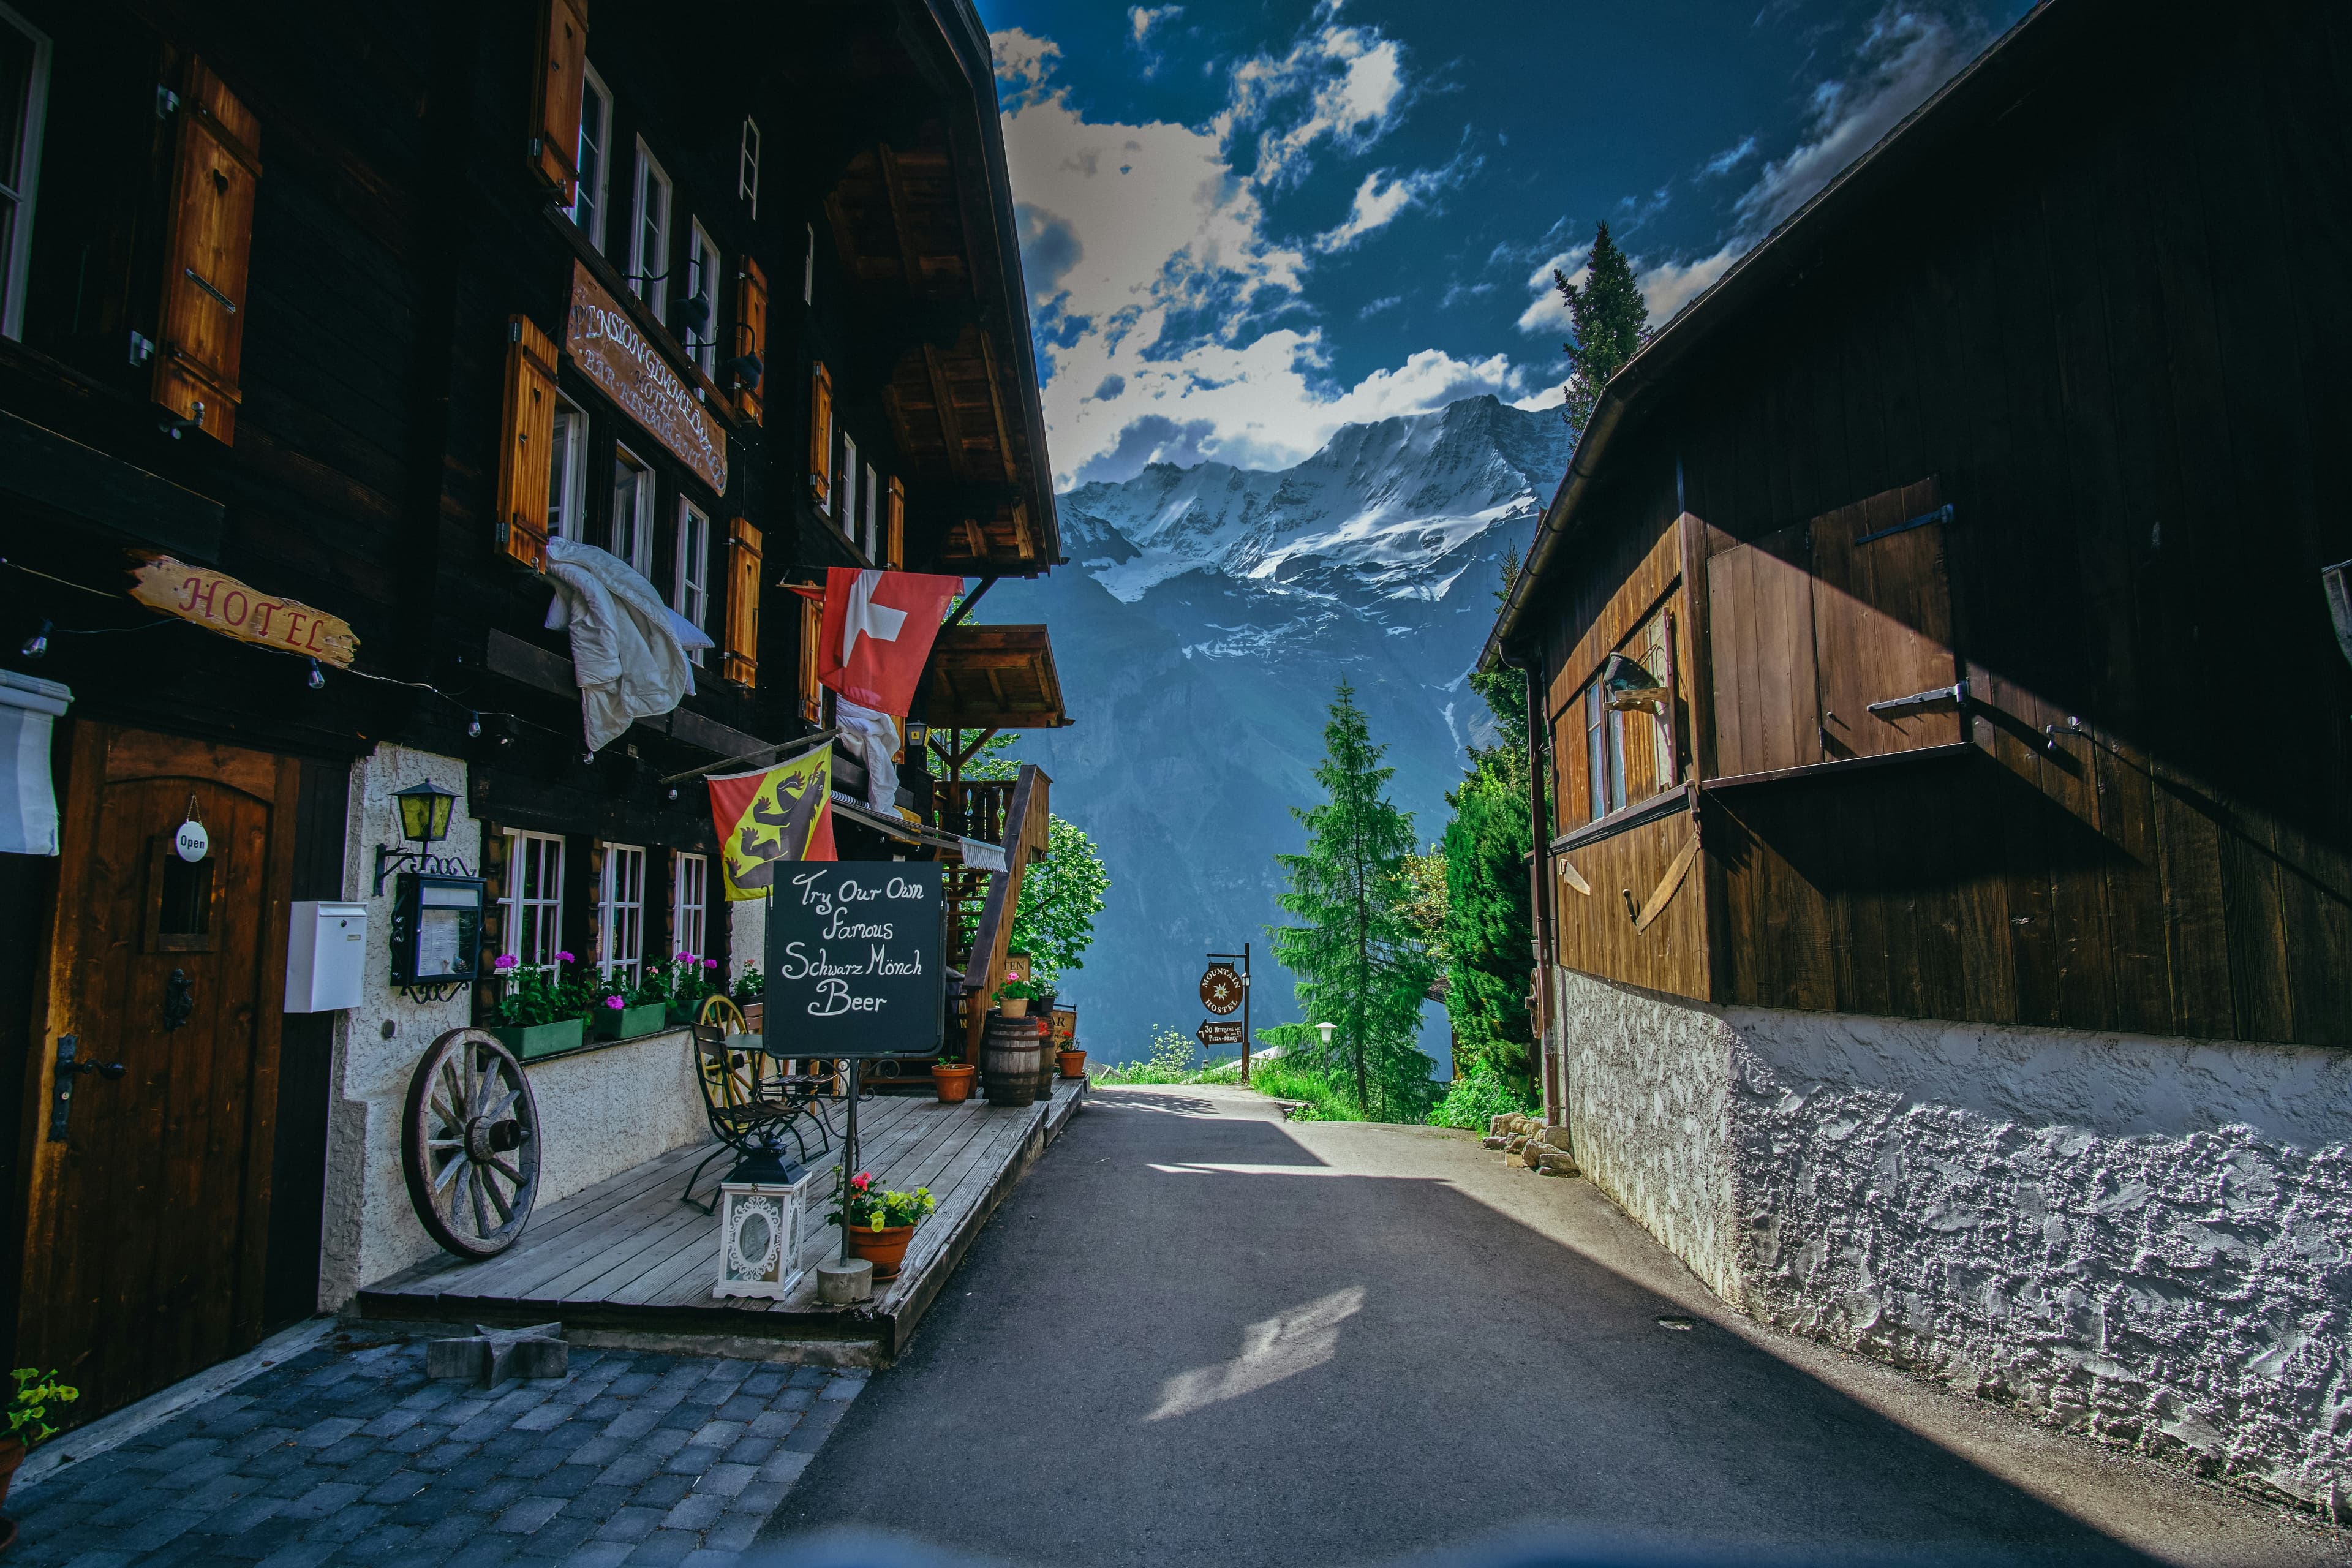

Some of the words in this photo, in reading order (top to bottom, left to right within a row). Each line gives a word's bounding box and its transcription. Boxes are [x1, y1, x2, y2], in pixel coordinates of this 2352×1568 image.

[572, 305, 647, 363] PENSION
[584, 349, 615, 390] BAR
[619, 382, 701, 469] RESTAURANT
[633, 370, 673, 421] HOTEL
[178, 577, 325, 653] HOTEL
[181, 835, 205, 850] Open
[792, 869, 832, 916] Try
[839, 880, 882, 902] Our
[886, 876, 924, 899] Own
[782, 941, 864, 979] Schwarz
[865, 943, 922, 976] Mönch
[1202, 968, 1241, 989] MOUNTAIN
[807, 978, 888, 1016] Beer
[1205, 998, 1238, 1014] HOSTEL
